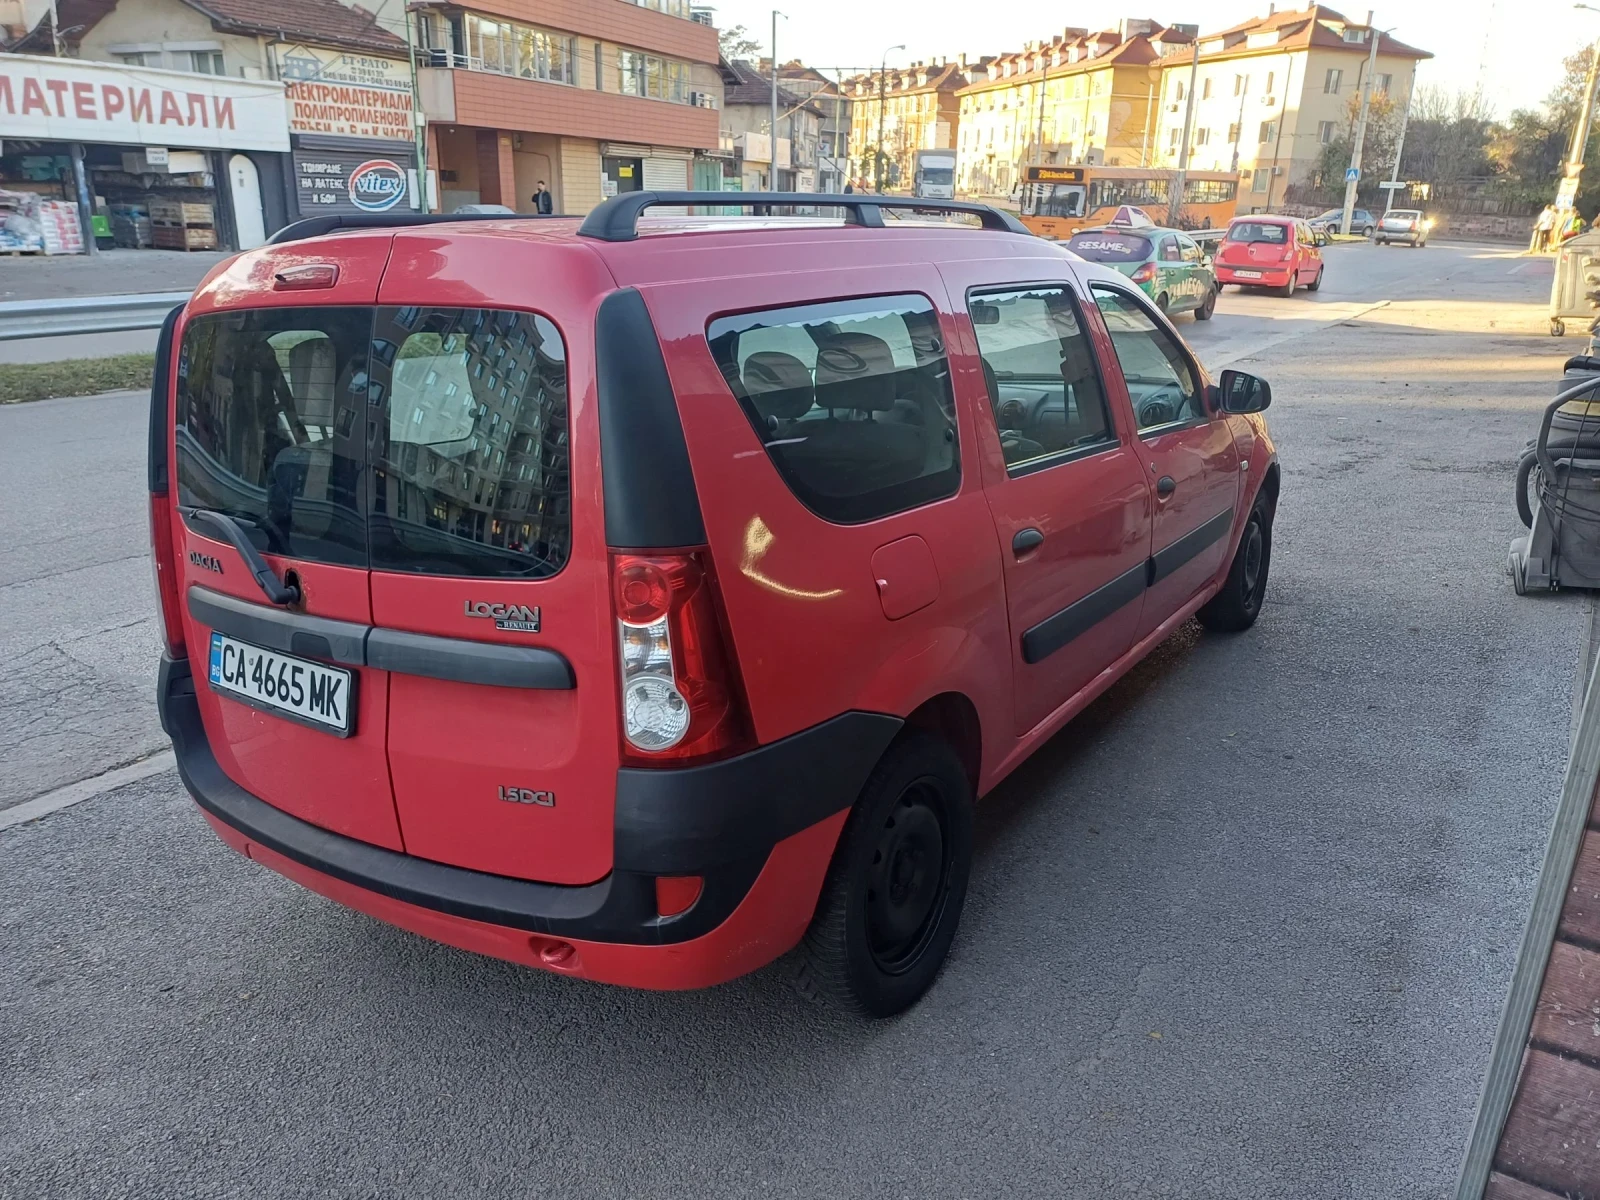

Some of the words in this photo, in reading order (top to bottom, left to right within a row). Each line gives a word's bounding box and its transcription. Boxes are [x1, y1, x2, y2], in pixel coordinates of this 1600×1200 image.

[294, 102, 408, 127] ПОЛИПРОПИЛЕНОВИ
[357, 173, 398, 192] vitex
[189, 551, 222, 574] DACIA
[464, 600, 540, 622] LOGAN
[503, 621, 536, 630] RENAULT
[211, 664, 220, 677] BG
[251, 655, 304, 707] 4665
